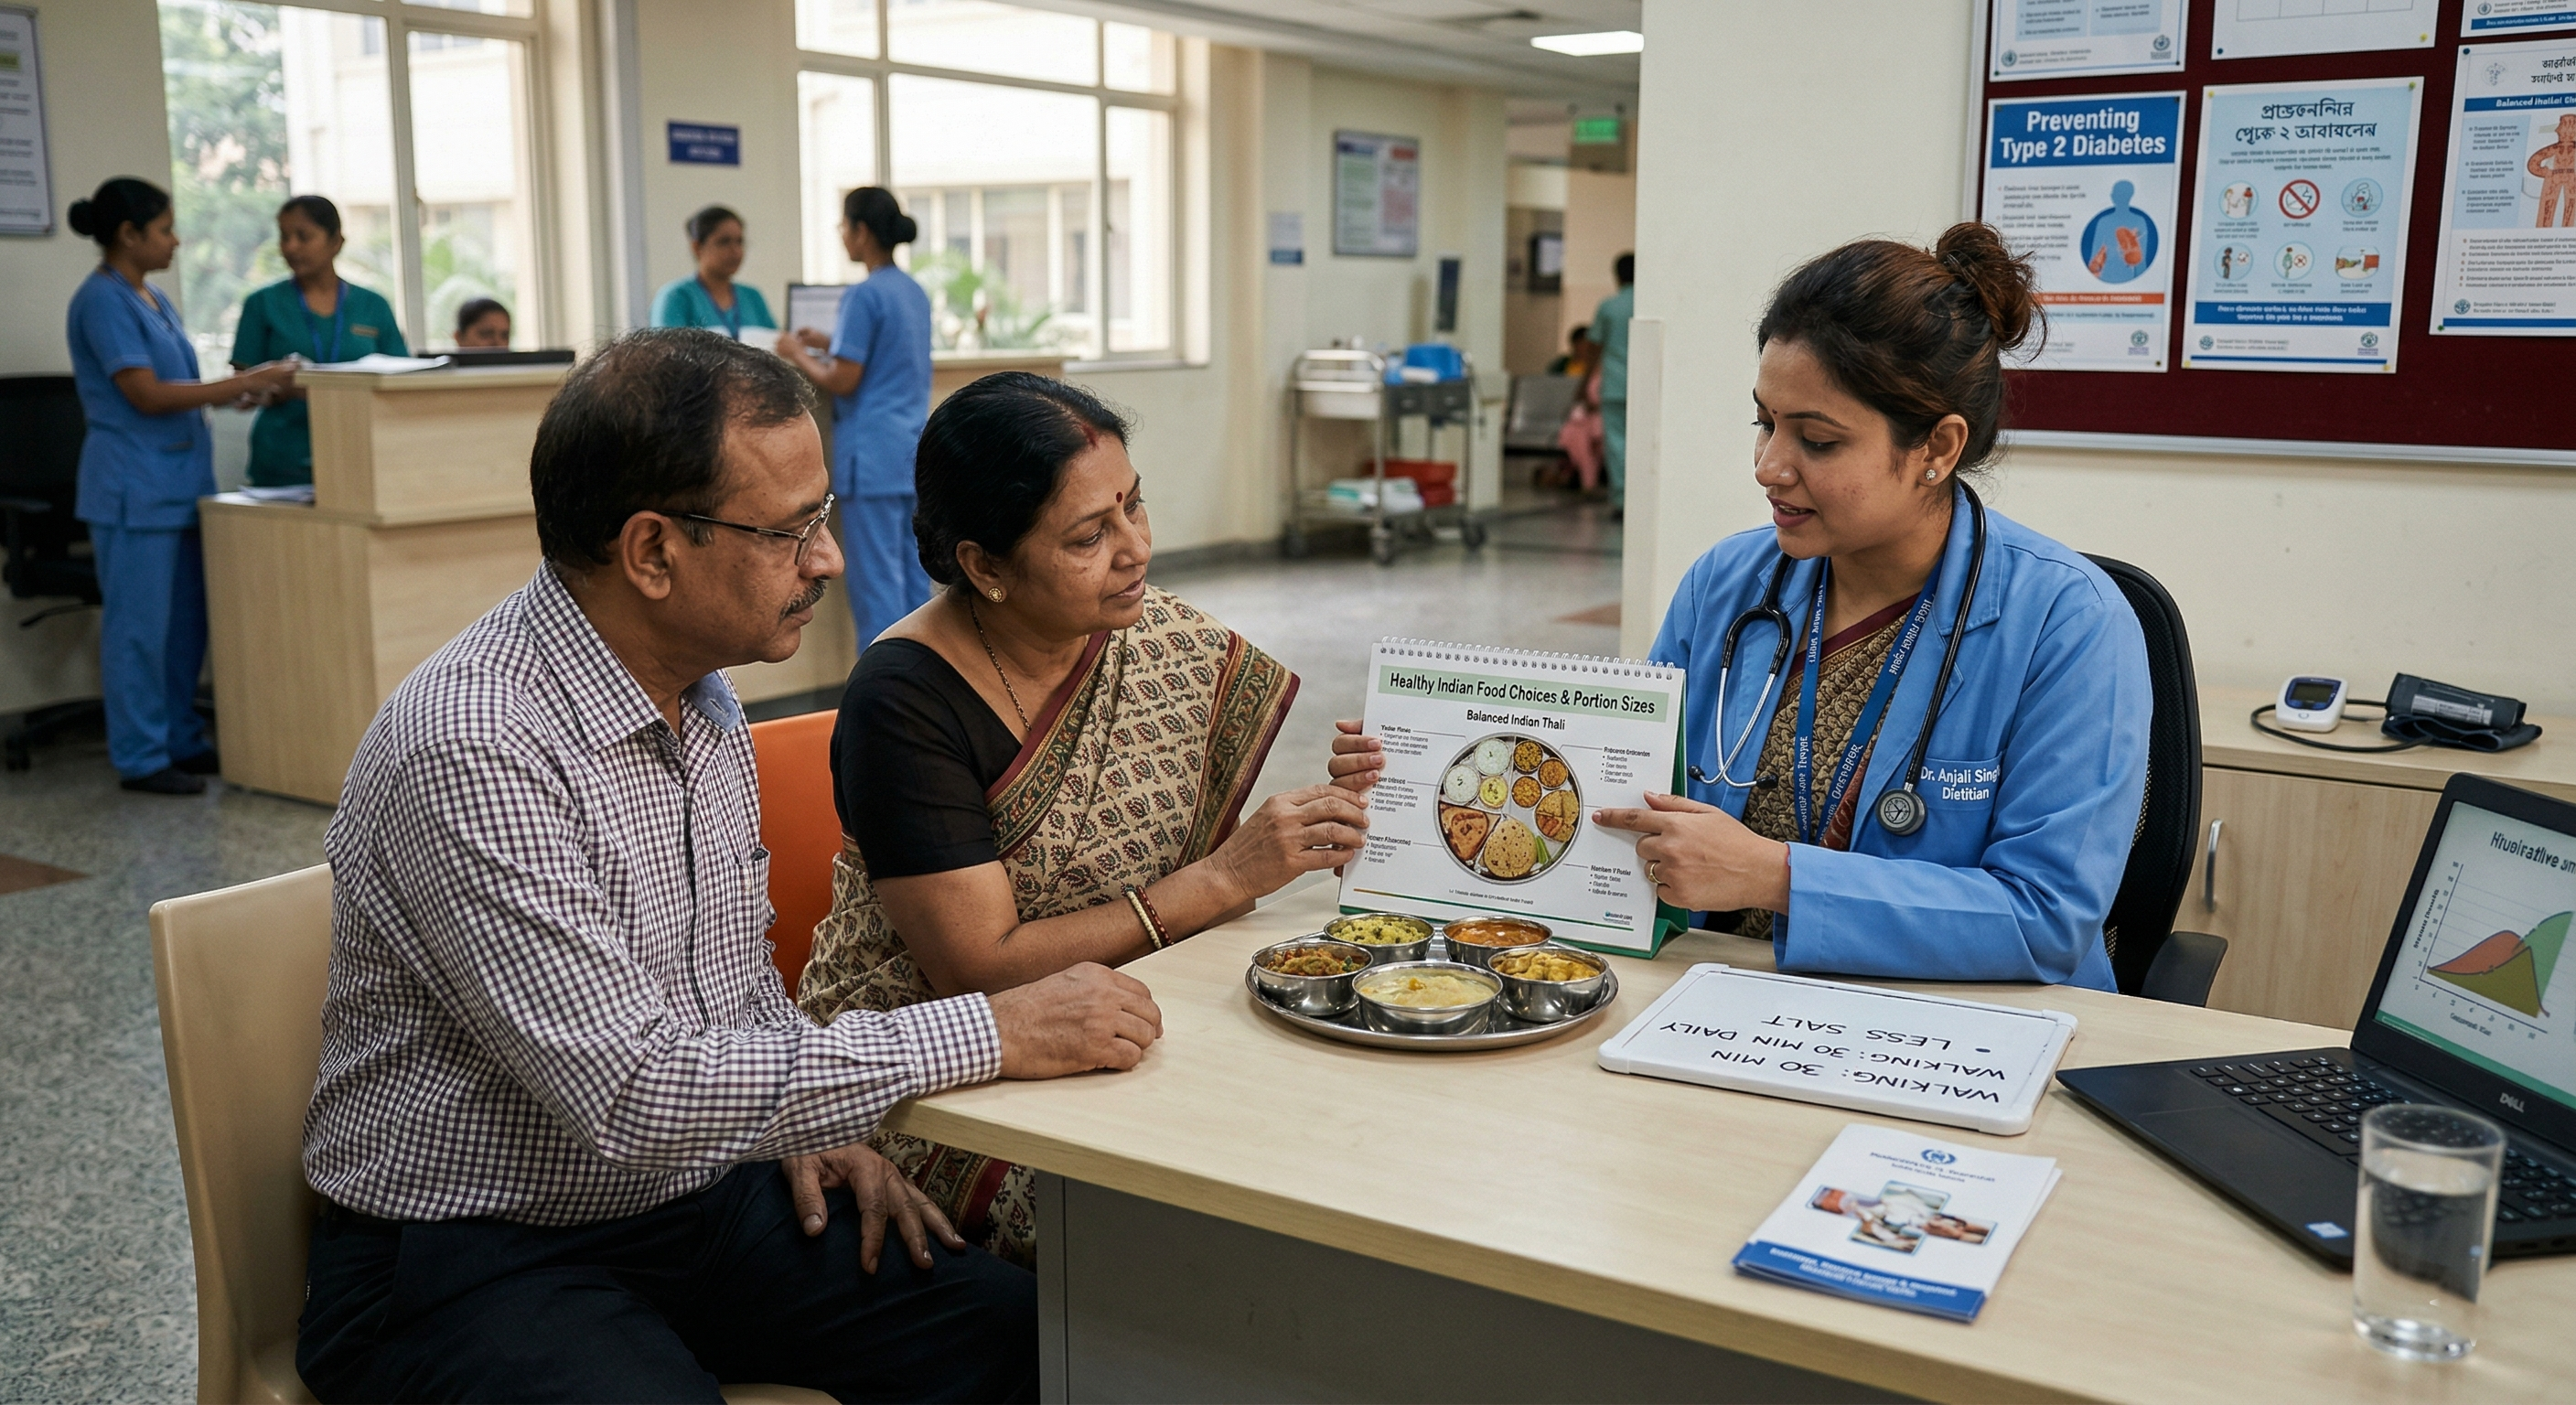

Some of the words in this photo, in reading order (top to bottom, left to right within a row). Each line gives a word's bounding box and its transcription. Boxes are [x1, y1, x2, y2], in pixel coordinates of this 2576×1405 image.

[2026, 107, 2141, 134] Preventing
[2000, 137, 2048, 164] Type
[2053, 135, 2066, 157] 2
[2072, 133, 2166, 156] Diabetes
[1390, 672, 1435, 695] Healthy
[1437, 677, 1474, 696] Indian
[1476, 681, 1507, 699] Food
[1508, 684, 1557, 704] Choices
[1560, 690, 1571, 705] &
[1573, 690, 1618, 711] Portion
[1621, 695, 1655, 714] Sizes
[1466, 709, 1509, 724] Balanced
[1510, 713, 1540, 728] Indian
[1542, 716, 1565, 730] Thali
[1920, 766, 1936, 781] Dr.
[1937, 767, 1971, 788] Anjali
[1942, 786, 1990, 801] Dietitian
[1659, 1022, 1738, 1041] DAILY
[1760, 1014, 1847, 1035] SALT
[1752, 1035, 1804, 1051] MIN
[1866, 1029, 1953, 1050] LESS
[1711, 1049, 1766, 1066] MIN
[1813, 1046, 1850, 1058] 30
[1779, 1061, 1824, 1077] 30
[1859, 1051, 2006, 1080] WALKING:
[1841, 1069, 2000, 1103] WALKING:
